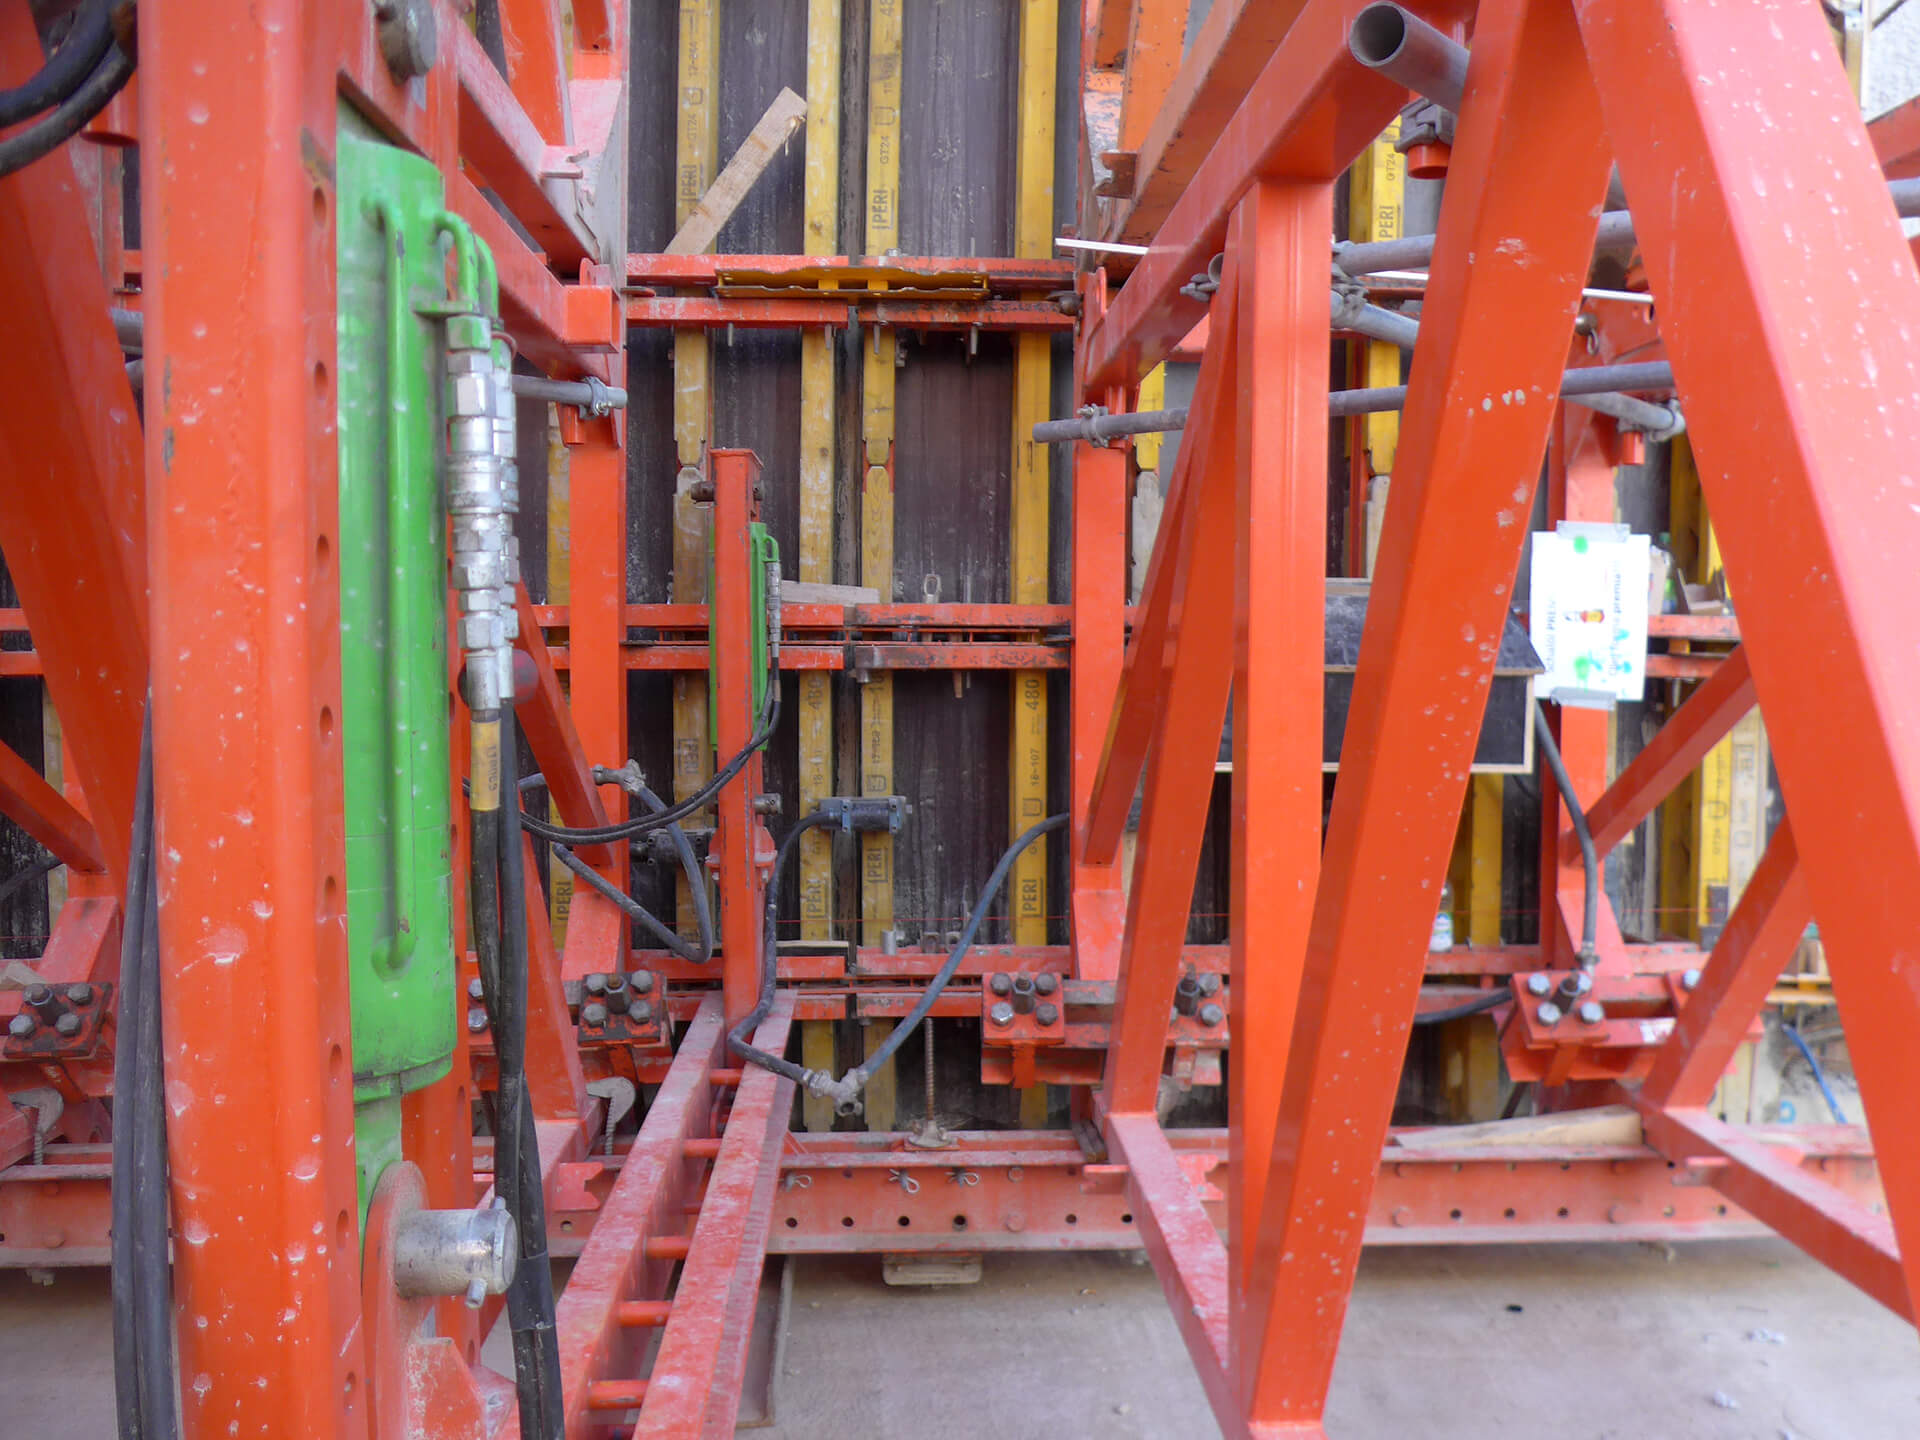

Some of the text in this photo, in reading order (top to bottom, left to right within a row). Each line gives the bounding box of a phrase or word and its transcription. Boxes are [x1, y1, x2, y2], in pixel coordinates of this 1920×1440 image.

[880, 135, 890, 164] GT24
[681, 164, 697, 197] PERI
[1379, 153, 1395, 239] PERI GT24
[873, 189, 888, 224] PERI
[808, 676, 824, 711] 480
[1025, 679, 1041, 711] 480
[867, 848, 882, 879] PERI
[556, 881, 572, 914] PERI
[807, 878, 821, 915] PERI
[1023, 878, 1037, 912] PERI
